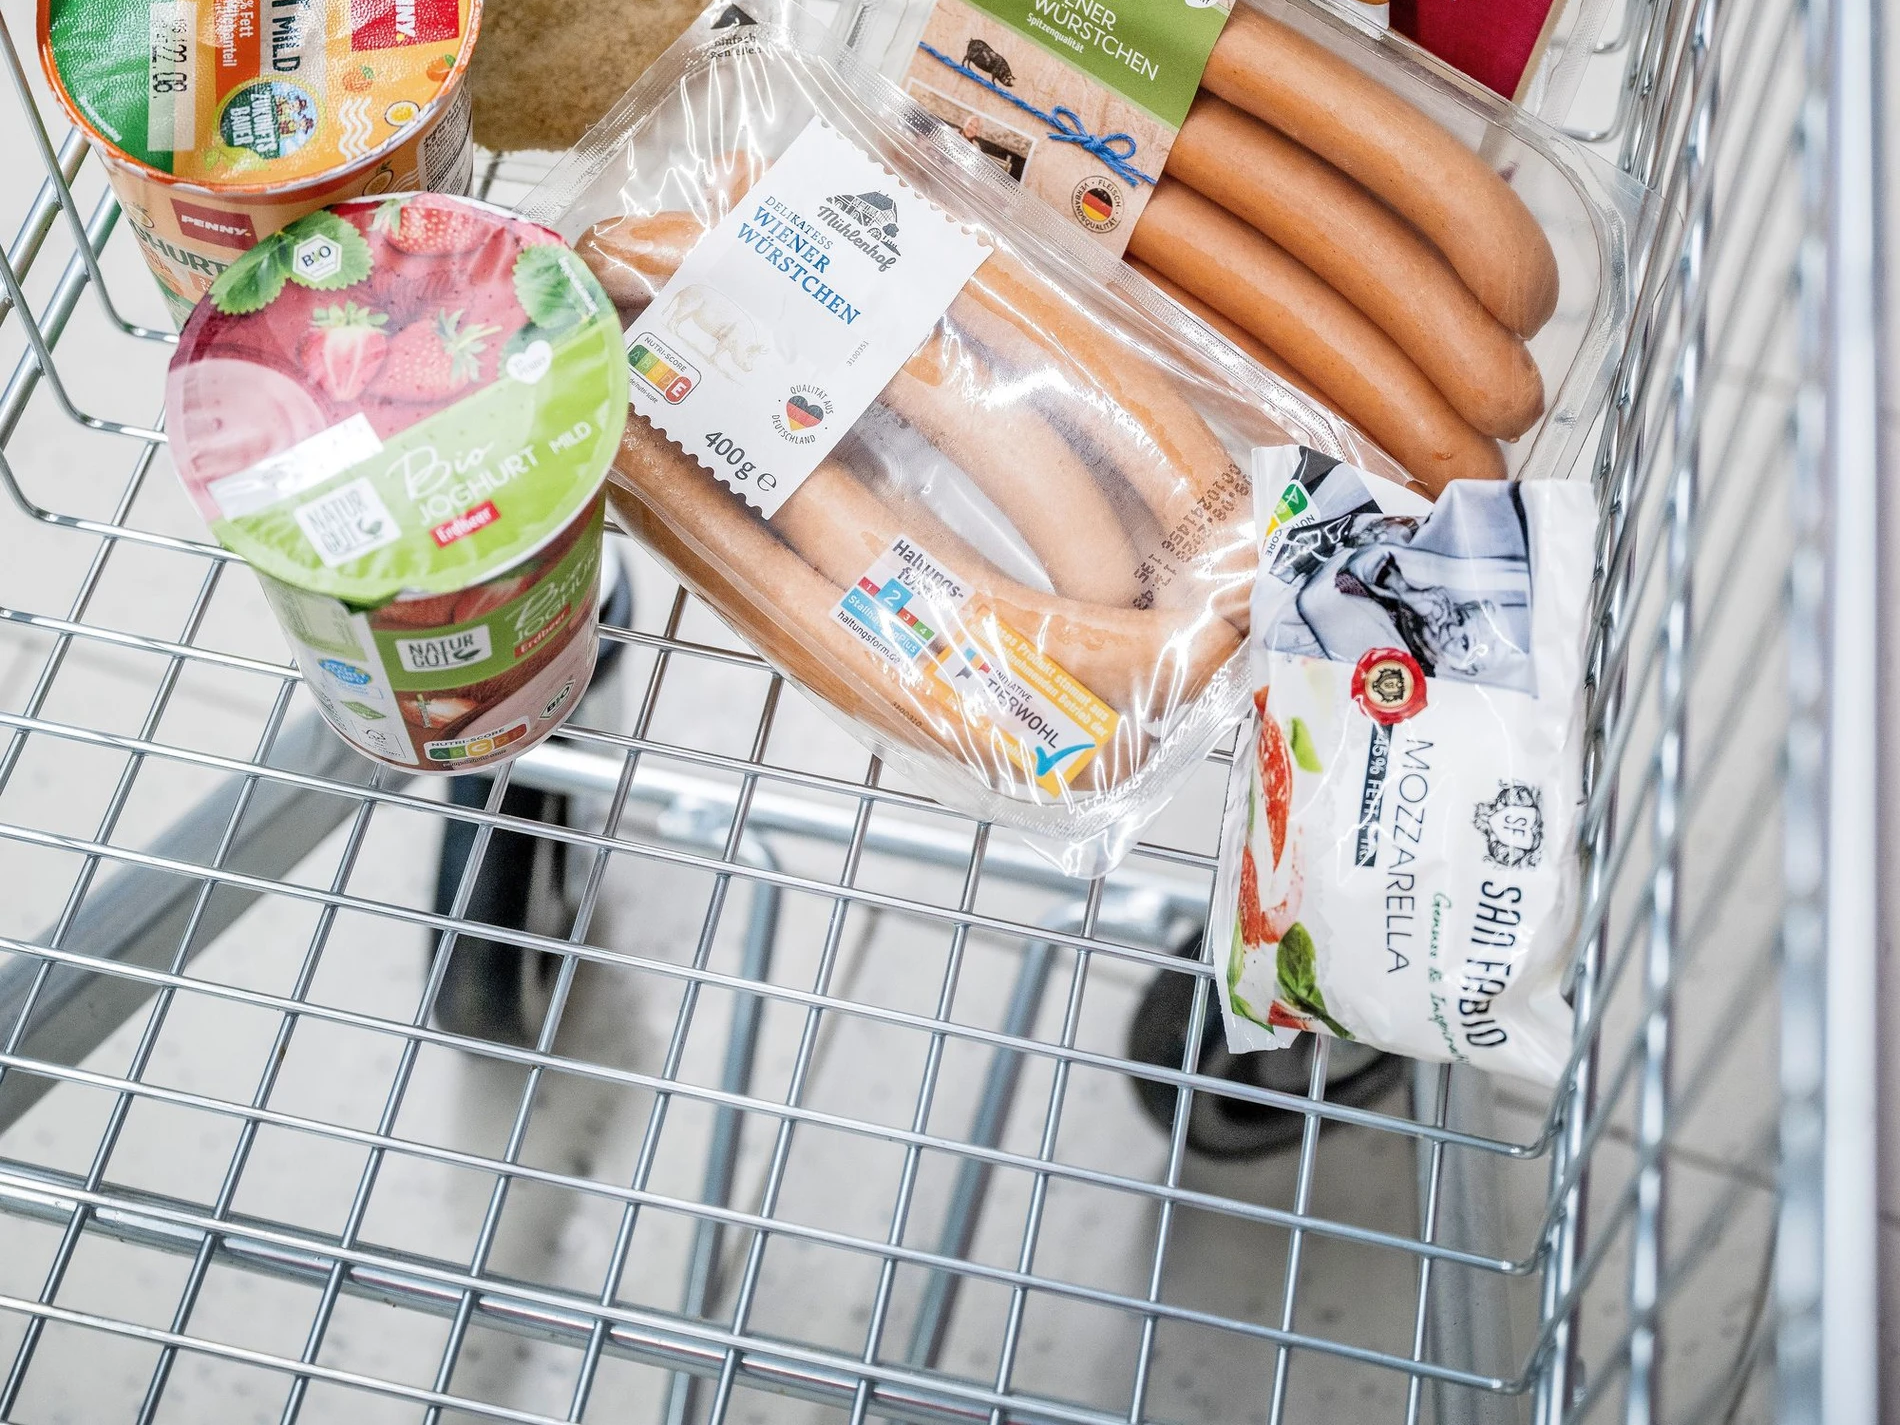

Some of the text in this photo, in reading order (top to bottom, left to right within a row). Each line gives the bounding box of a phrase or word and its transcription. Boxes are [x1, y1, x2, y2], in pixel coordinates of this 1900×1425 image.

[240, 12, 254, 38] Fett
[272, 16, 301, 72] MILD
[1027, 13, 1085, 54] Spitzenqualität
[230, 106, 254, 146] BAUER
[1098, 179, 1121, 207] FLEISCH
[753, 205, 831, 274] WIENER
[764, 196, 834, 250] DELIKATESS
[816, 205, 897, 273] Mühlenhof
[737, 222, 861, 325] WÜRSTCHEN
[644, 336, 687, 373] NUTRI-SCORE
[846, 340, 870, 367] 3100351
[671, 381, 687, 398] E
[823, 400, 834, 416] AUS
[771, 414, 816, 445] DEUTSCHLAND
[385, 441, 494, 502] Bio
[419, 421, 593, 527] JOGHURT MILD
[306, 487, 368, 530] NATUR
[321, 524, 361, 554] GUT
[883, 589, 902, 607] 2
[408, 633, 474, 657] NATUR
[520, 610, 567, 653] Erdbeer
[411, 649, 449, 667] GUT
[1017, 642, 1110, 722] Produkt stammt aus
[985, 678, 1061, 749] TIERWOHL
[1090, 721, 1109, 737] der
[431, 727, 505, 747] NUTRI-SCORE
[1503, 814, 1527, 840] SF
[1386, 738, 1435, 974] MOZZARELLA
